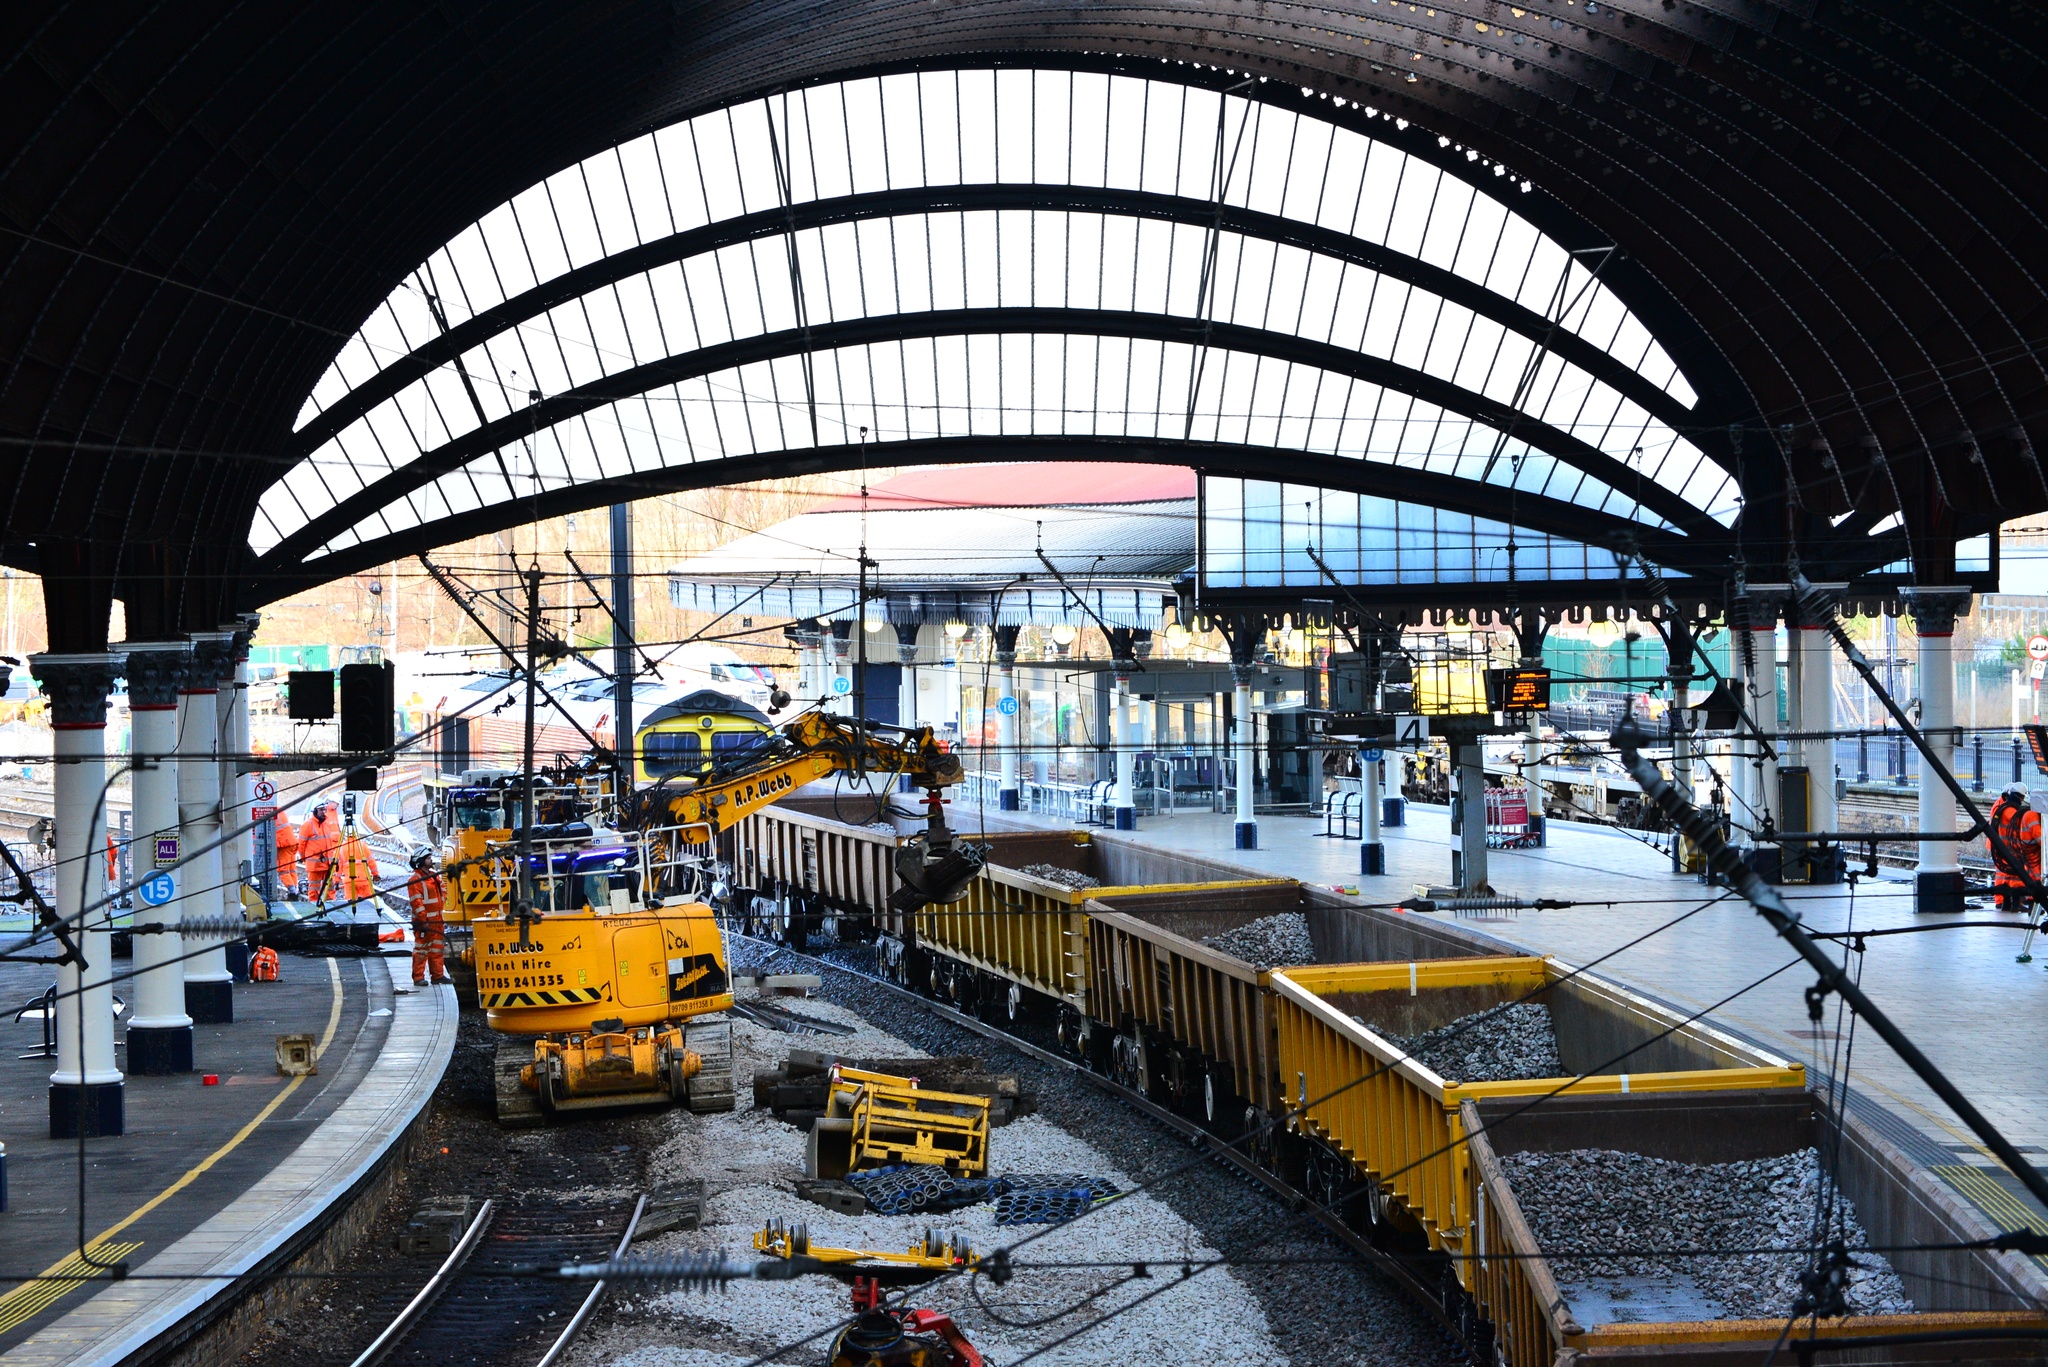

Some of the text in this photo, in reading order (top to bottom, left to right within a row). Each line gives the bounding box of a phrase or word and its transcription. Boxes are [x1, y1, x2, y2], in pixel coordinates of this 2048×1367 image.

[836, 682, 847, 691] 17
[1002, 702, 1015, 712] 16
[1401, 720, 1424, 749] 4
[1366, 747, 1380, 757] 15
[734, 772, 792, 808] A.P.Webb
[160, 845, 175, 854] ALL
[146, 881, 169, 899] 15
[485, 959, 552, 971] Plant Hire
[480, 974, 565, 988] 01785 241335
